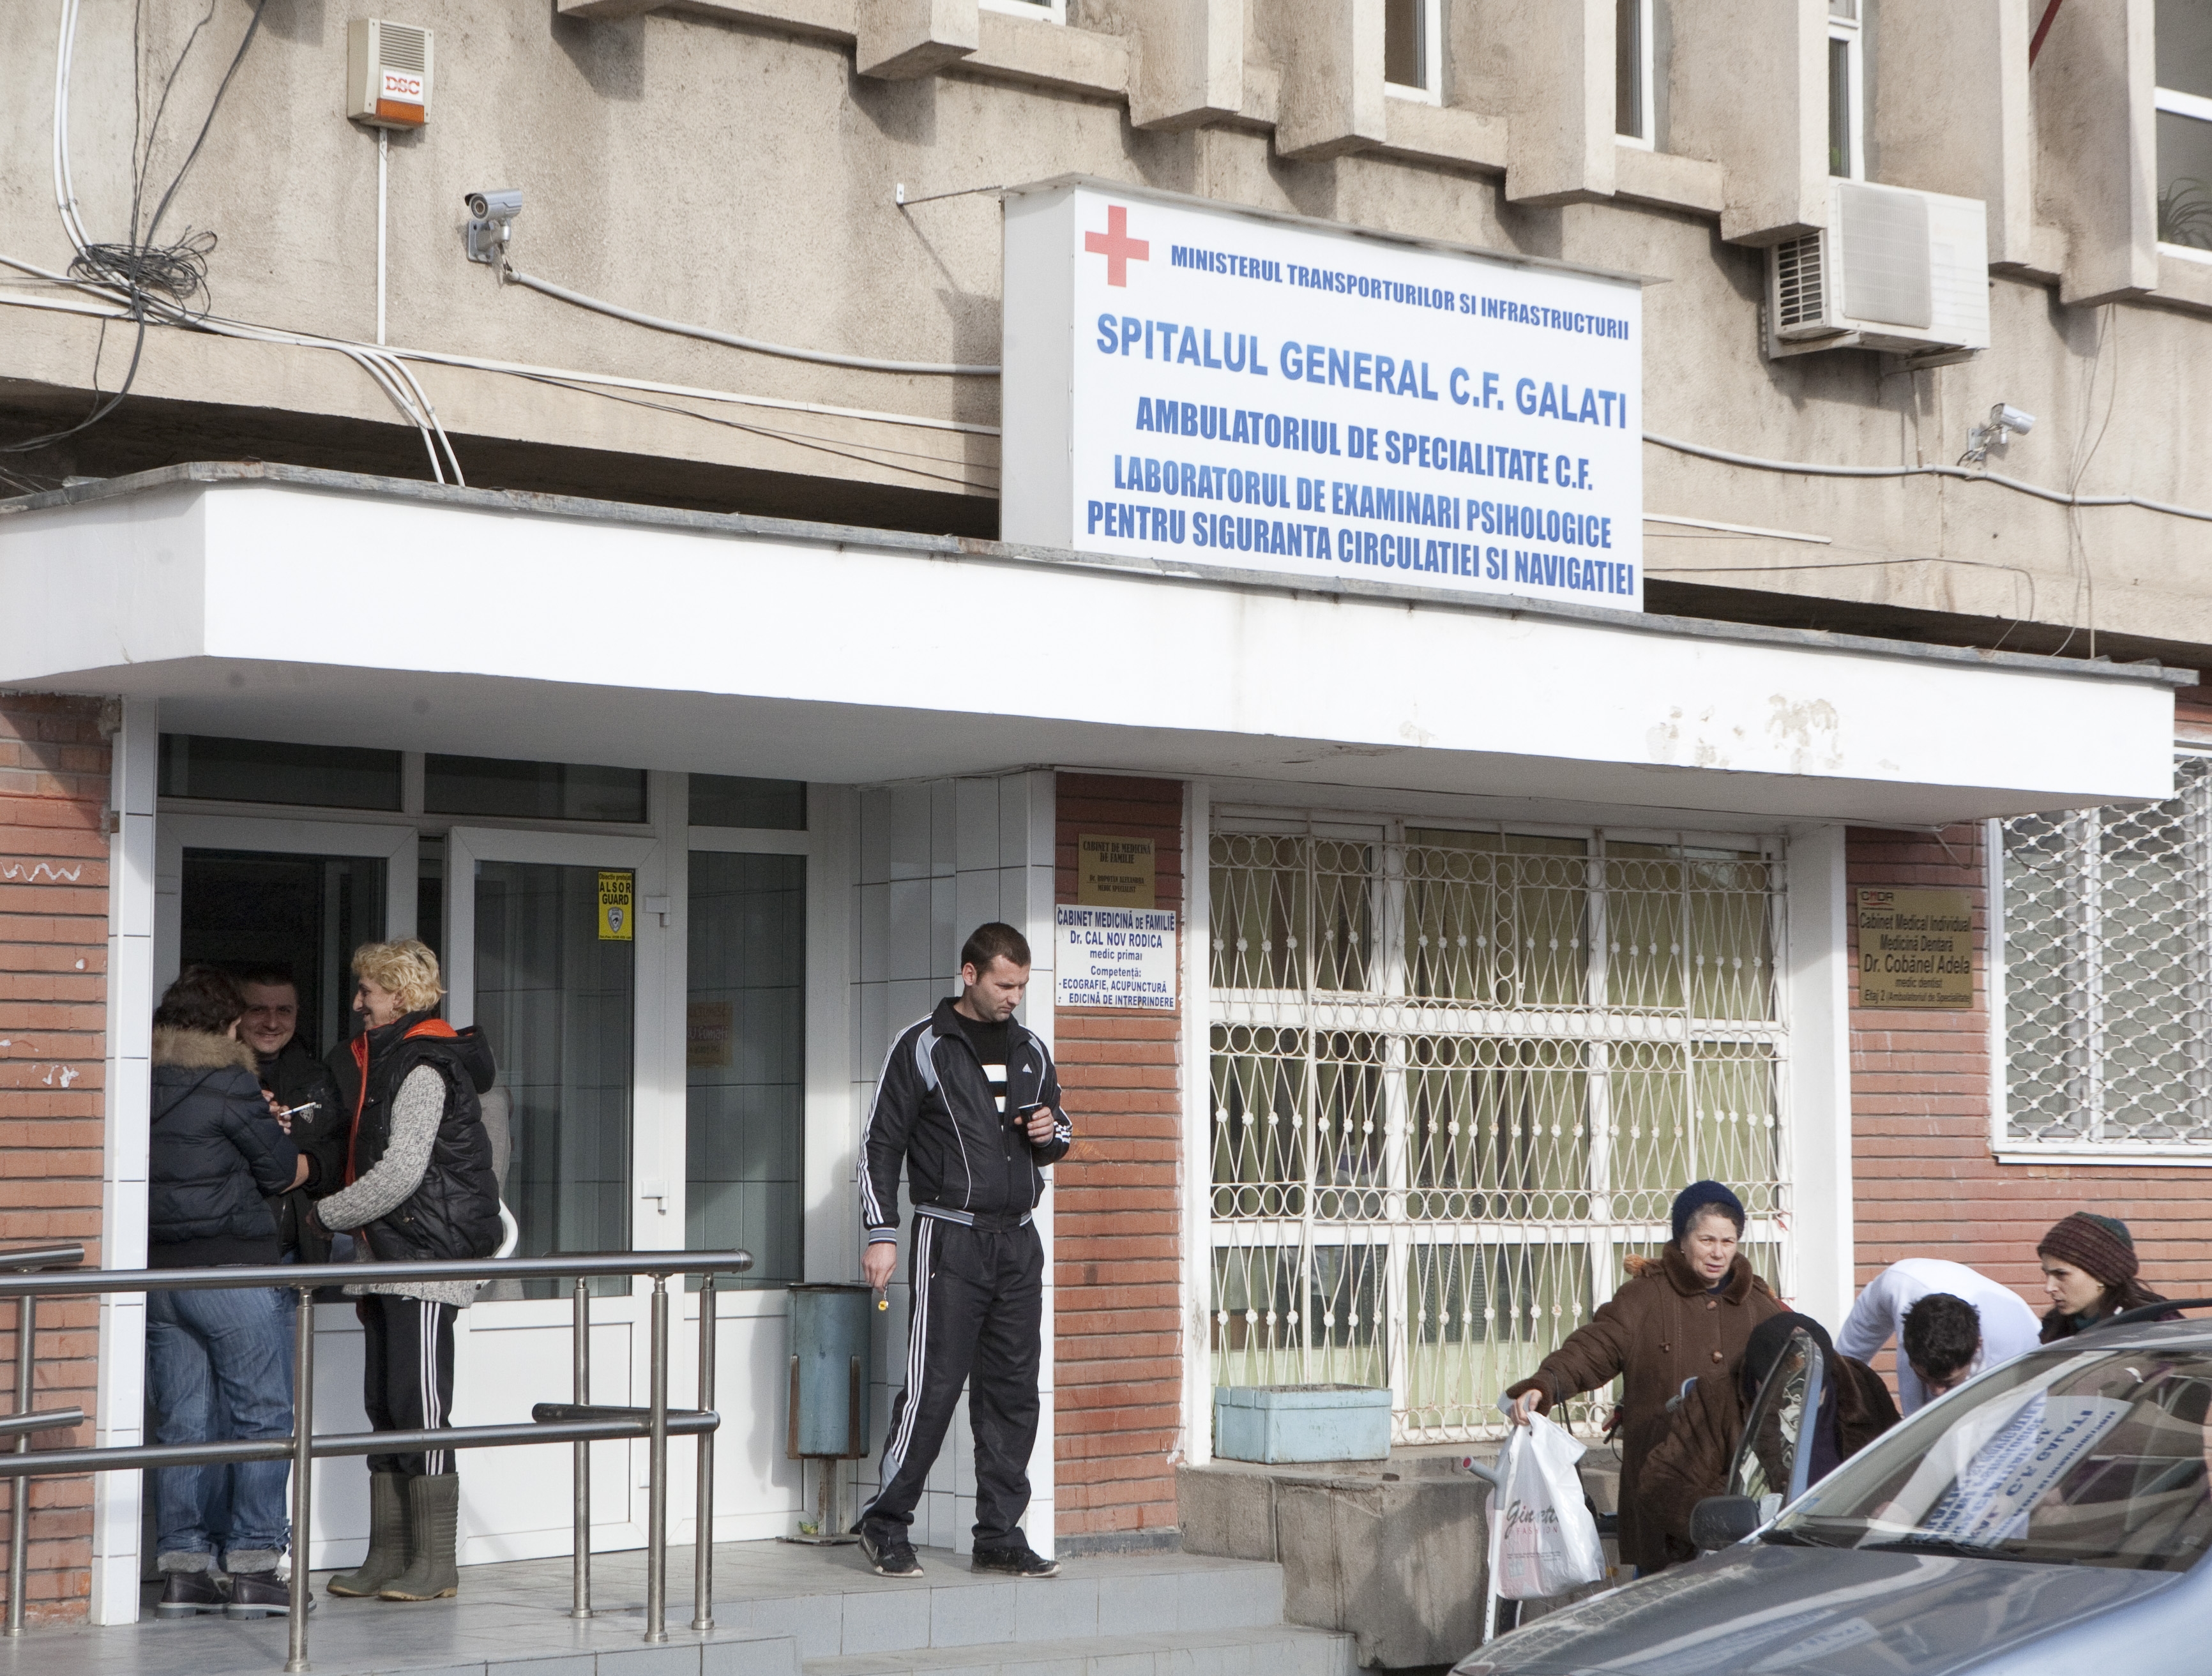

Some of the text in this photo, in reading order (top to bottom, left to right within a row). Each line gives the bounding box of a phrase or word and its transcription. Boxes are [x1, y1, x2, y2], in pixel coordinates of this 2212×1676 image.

[386, 75, 420, 95] DSC
[1172, 245, 1628, 340] MINISTERUL TRANSPORTURILOR SI INFRASTRUCTURII
[1096, 313, 1626, 428] SPITALUL GENERAL C.F. GALATI
[1135, 396, 1593, 490] AMBULATORIUL DE SPECIALITATE C.F.
[1114, 454, 1612, 548] LABORATORUL DE EXAMINARI PSIHOLOGICE
[1087, 500, 1633, 595] PENTRU SIGURANTA CIRCULATIEI SI NAVIGATIEI
[1083, 841, 1110, 852] CABINET
[1111, 842, 1120, 853] DE
[1100, 852, 1135, 864] DE FAMILIE
[600, 882, 631, 893] ALSOR
[602, 894, 629, 905] GUARD
[1057, 909, 1093, 926] CABINET
[1095, 910, 1133, 930] MEDICINĂ
[1145, 914, 1174, 931] FAMILIE
[1860, 912, 1971, 932] Cabinet Medical Individual
[1070, 930, 1083, 944] Dr.
[1128, 933, 1162, 949] RODICA
[1089, 948, 1115, 960] medic
[1863, 953, 1881, 972] Dr.
[1936, 955, 1971, 974] Adela
[1110, 980, 1167, 993] ACUPUNCTURĂ
[1102, 994, 1113, 1005] DE
[1114, 995, 1174, 1008] INTREPRINDERE
